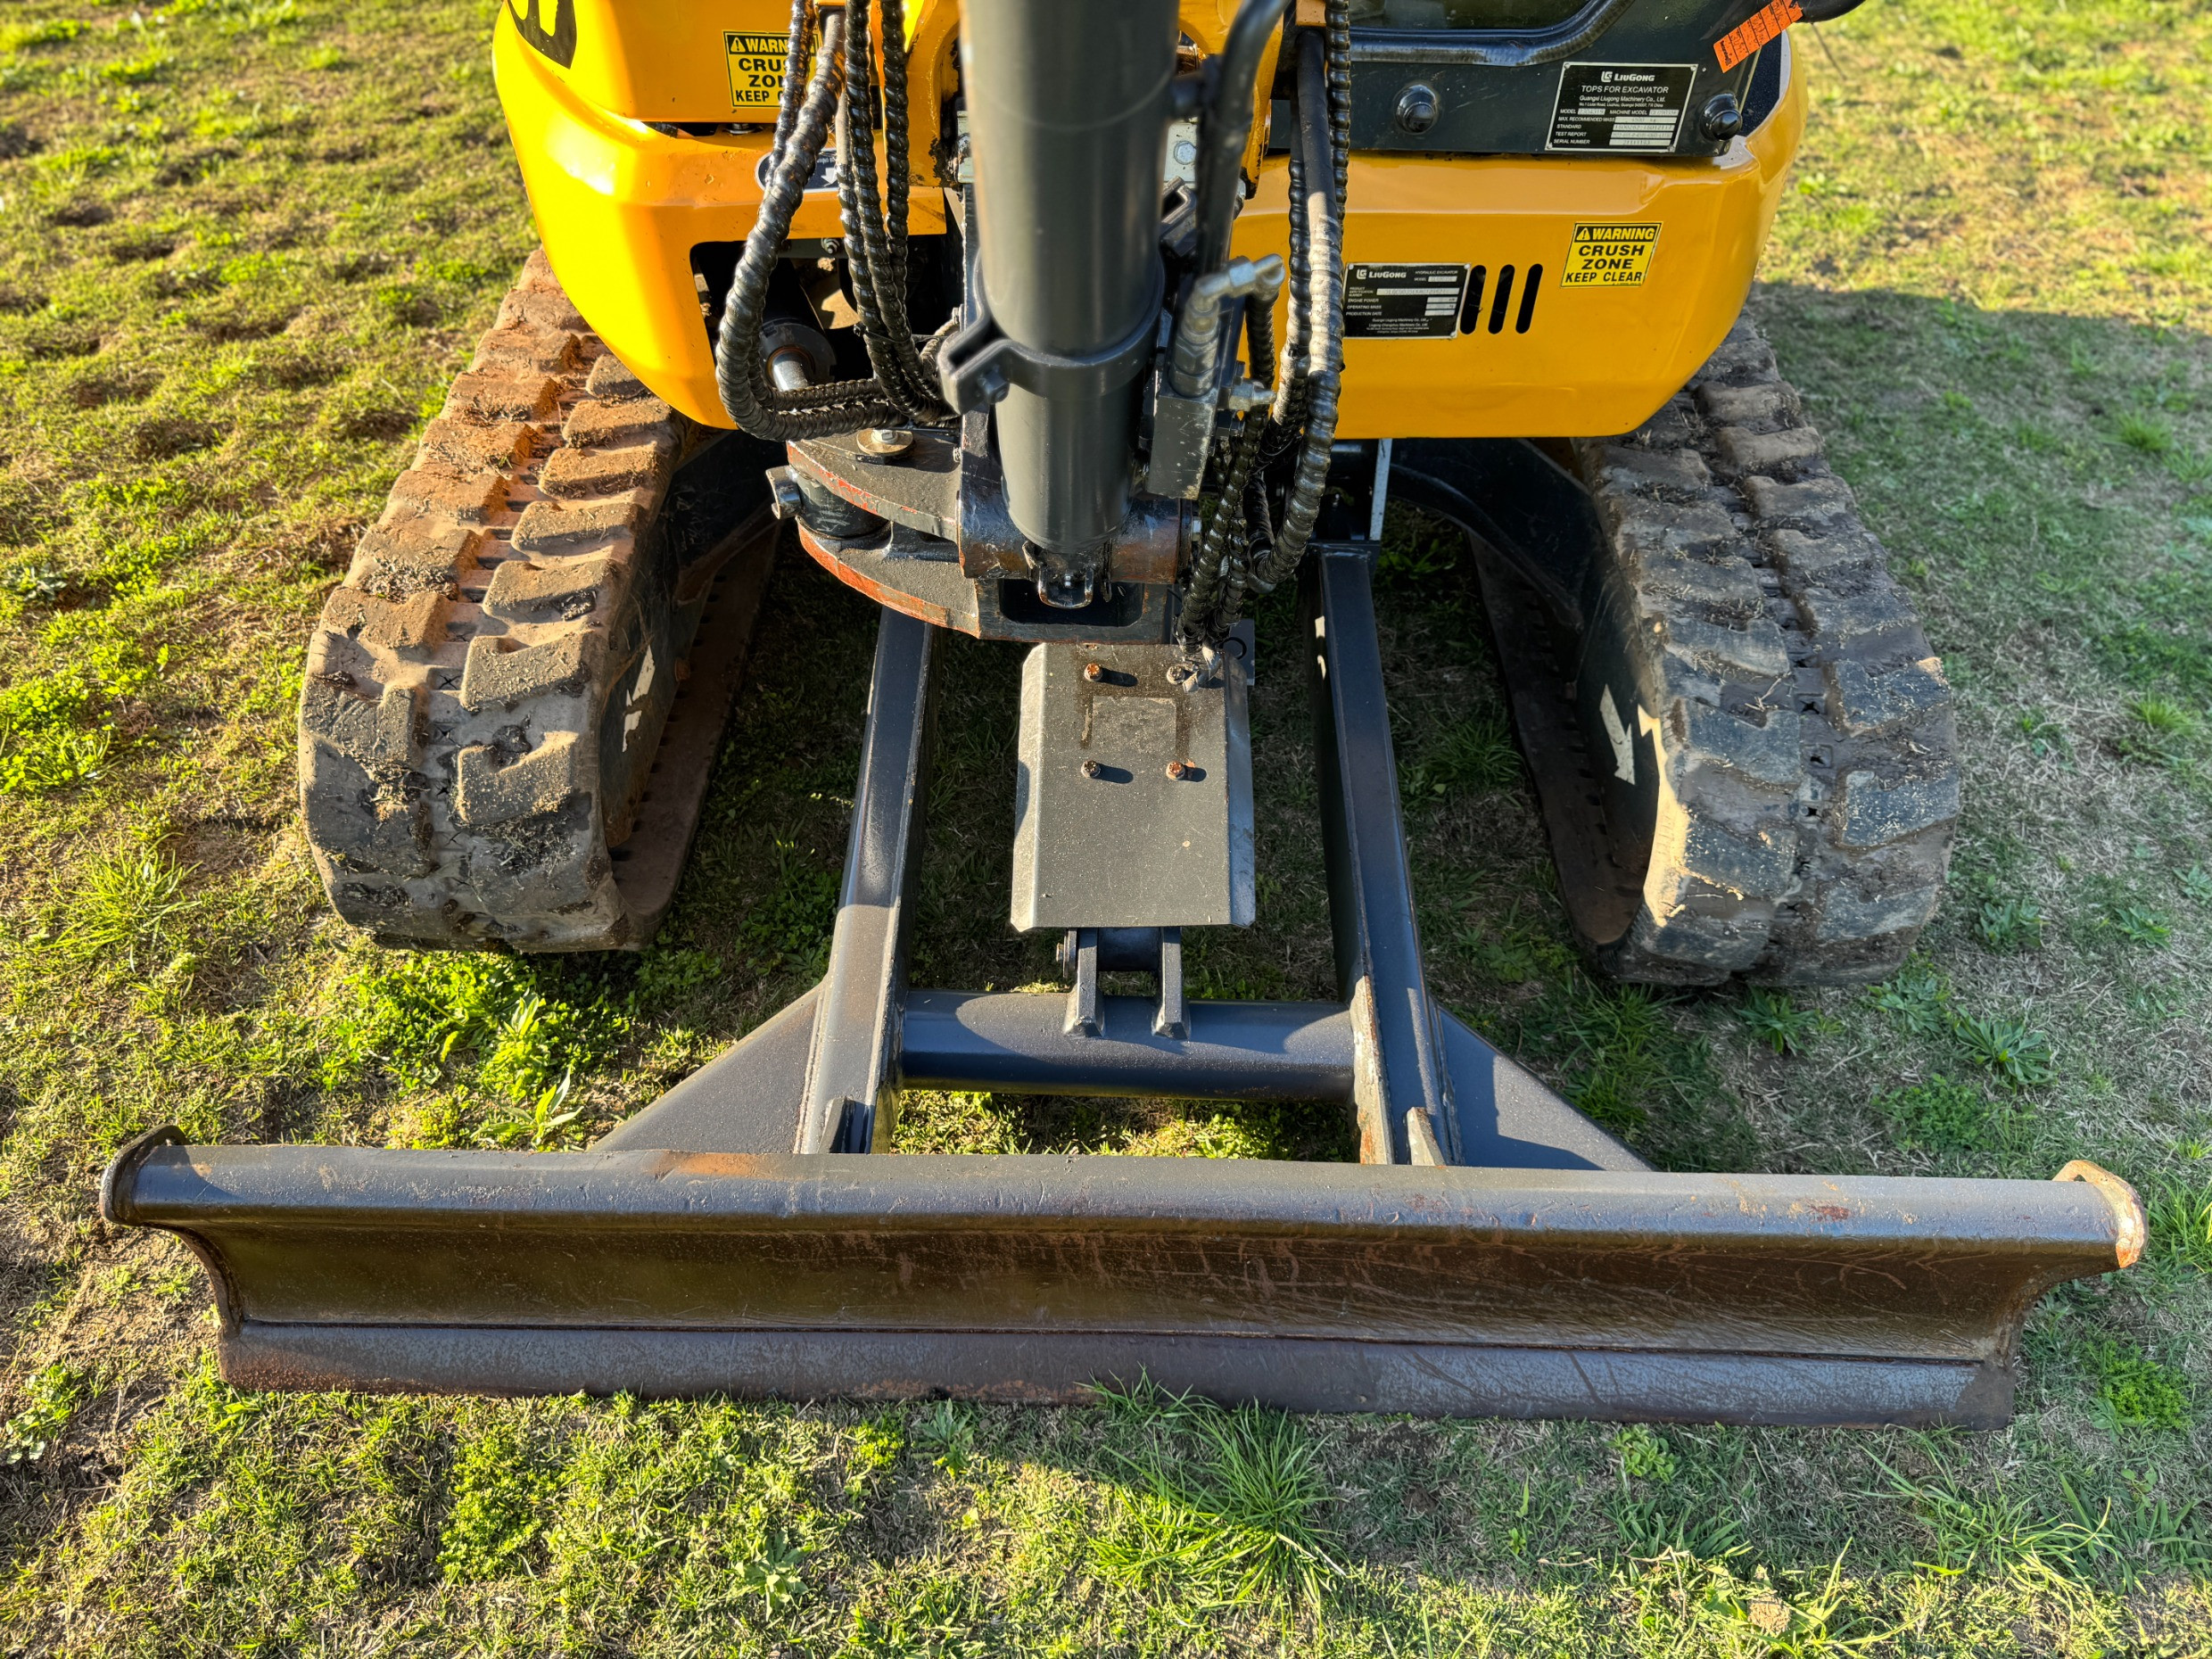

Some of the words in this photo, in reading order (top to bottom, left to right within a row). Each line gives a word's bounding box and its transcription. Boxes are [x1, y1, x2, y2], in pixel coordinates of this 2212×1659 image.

[1622, 86, 1669, 94] EXCAVATOR
[736, 90, 769, 103] KEEP
[1592, 227, 1655, 240] WARNING
[1579, 244, 1645, 256] CRUSH
[1581, 259, 1634, 269] ZONE
[1565, 272, 1597, 283] KEEP
[1603, 272, 1643, 282] CLEAR
